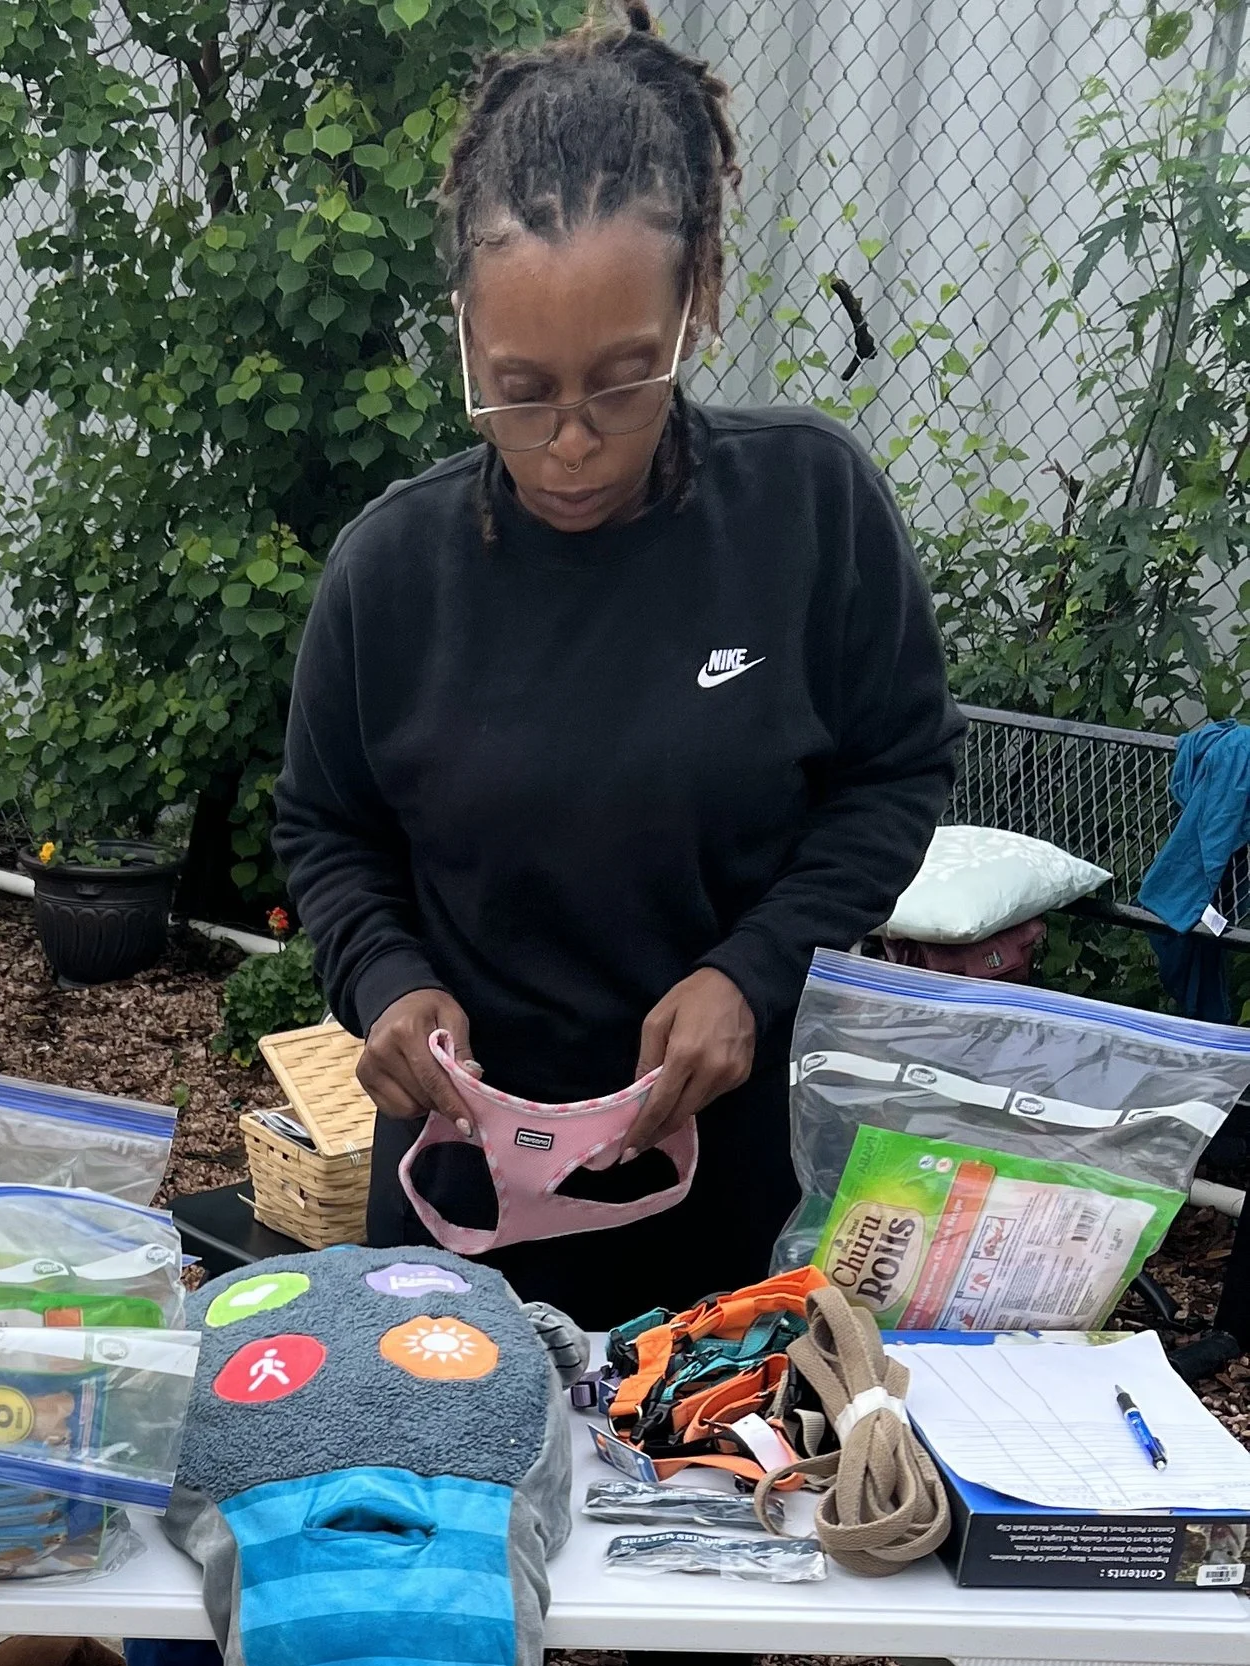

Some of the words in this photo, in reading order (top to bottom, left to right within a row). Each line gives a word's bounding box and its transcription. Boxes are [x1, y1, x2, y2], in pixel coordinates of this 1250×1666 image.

[708, 649, 747, 671] NIKE
[832, 1216, 882, 1288] Churu
[856, 1217, 916, 1304] Rolls
[620, 1531, 675, 1546] SHELTER
[1152, 1535, 1173, 1543] Quick
[1125, 1545, 1153, 1553] Quality
[1106, 1567, 1165, 1580] Contents
